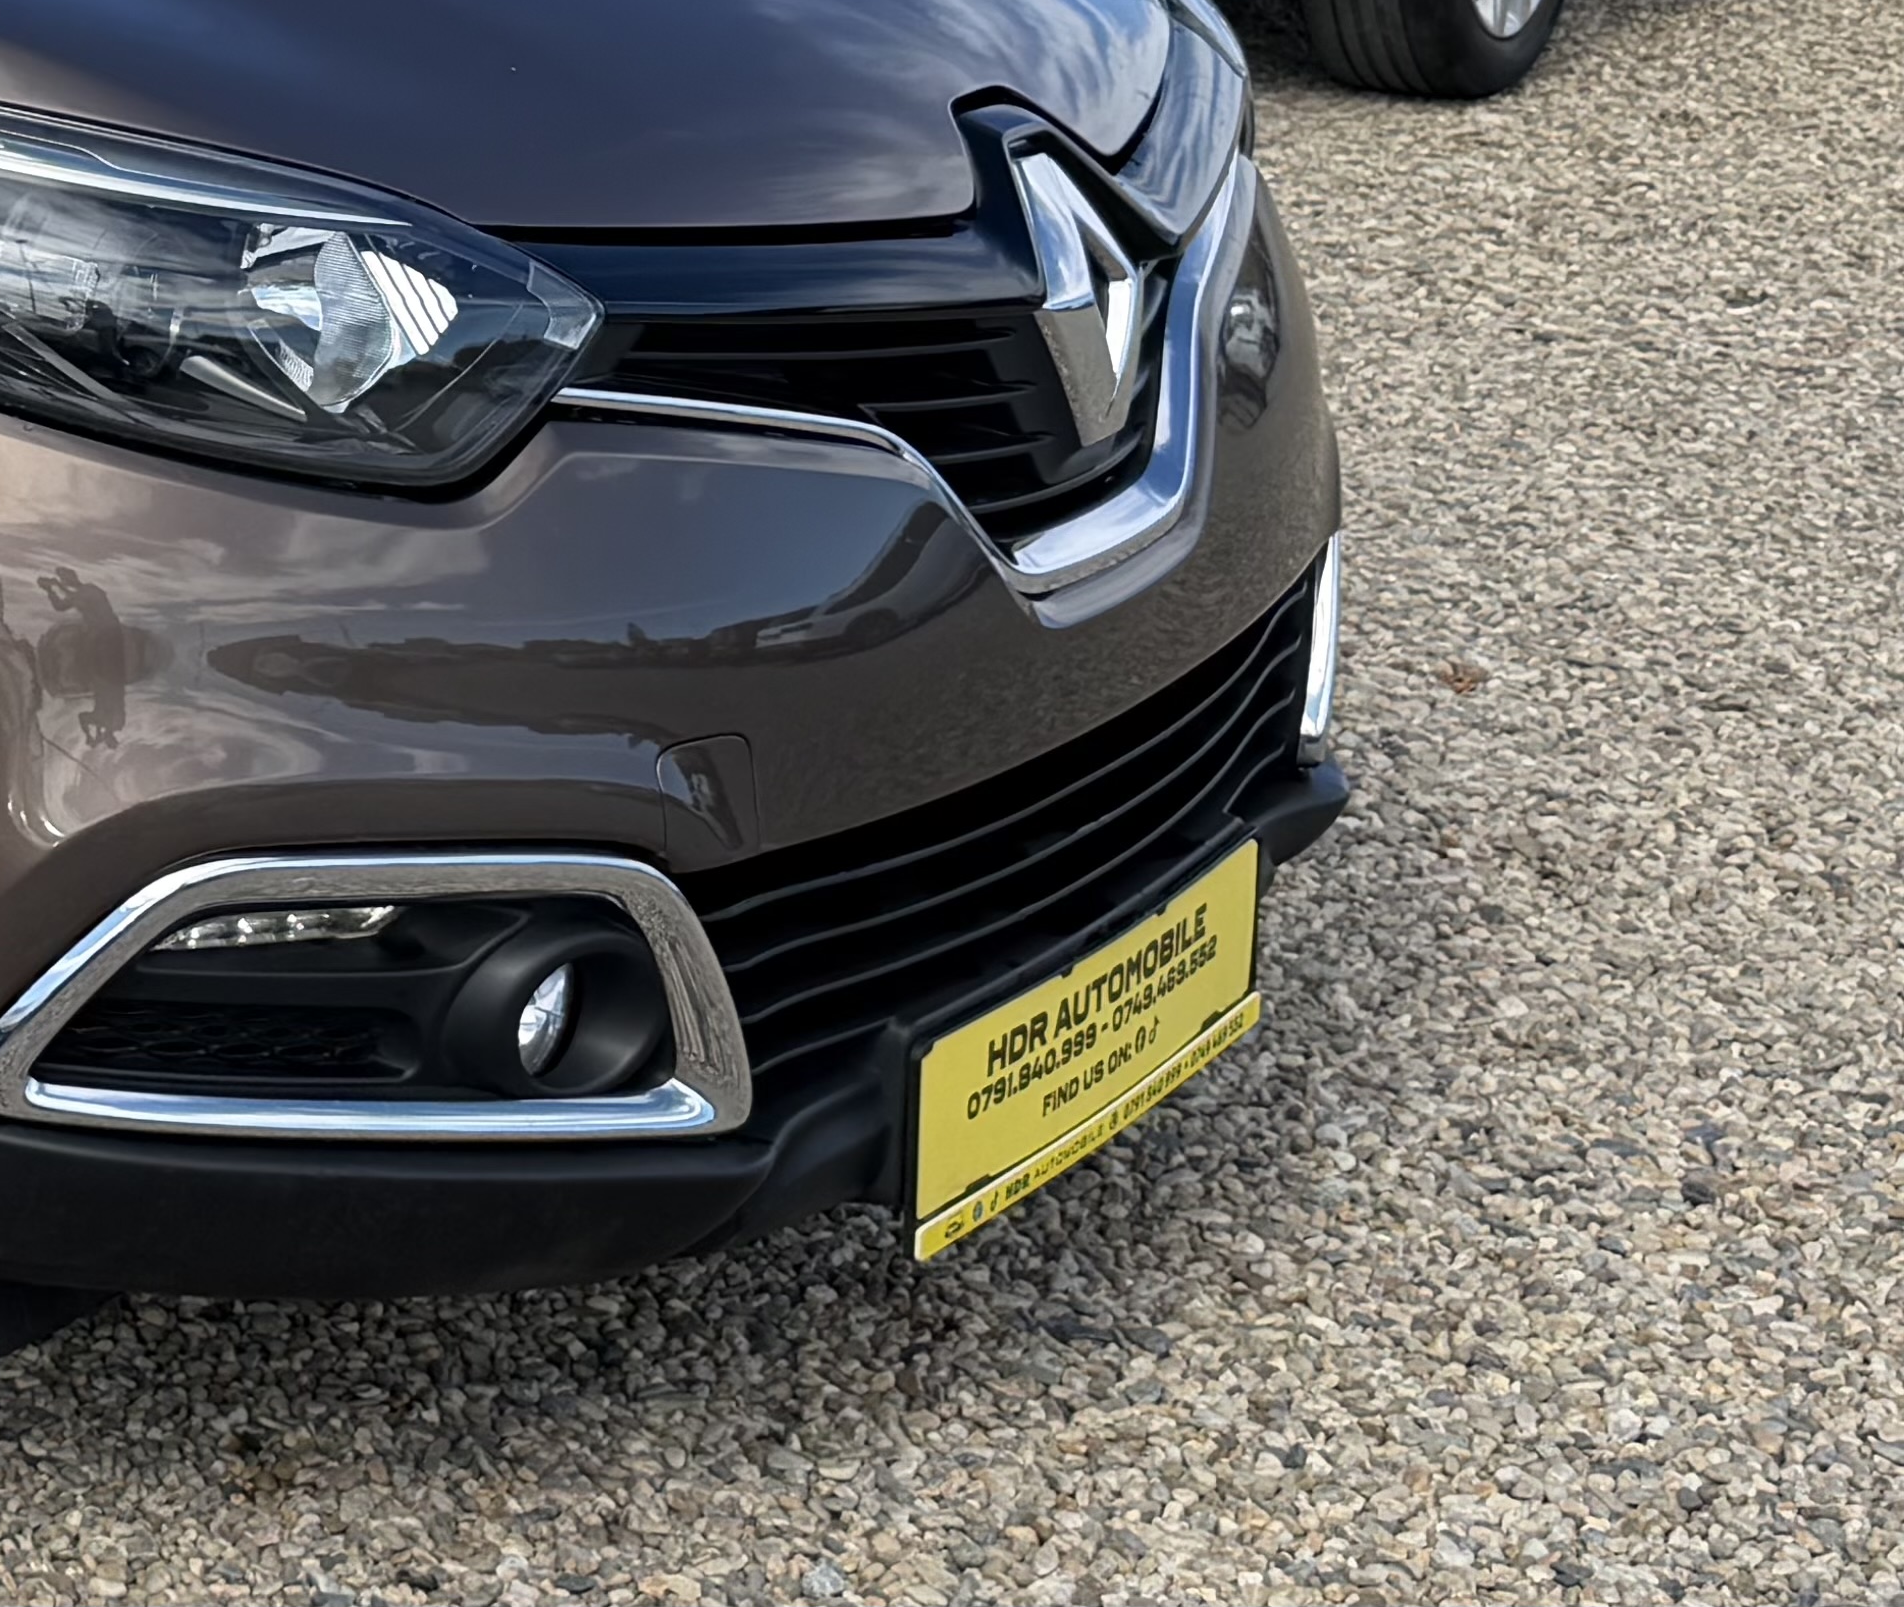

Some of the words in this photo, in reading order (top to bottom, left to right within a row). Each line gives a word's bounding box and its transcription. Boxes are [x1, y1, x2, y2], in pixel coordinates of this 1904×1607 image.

[986, 1011, 1049, 1078] HDR
[1053, 902, 1208, 1039] AUTOMOBILE
[967, 1022, 1097, 1121] 0791.840.999
[1042, 1076, 1080, 1118] FIND
[1083, 1059, 1105, 1091] US
[1108, 1041, 1132, 1074] ON:
